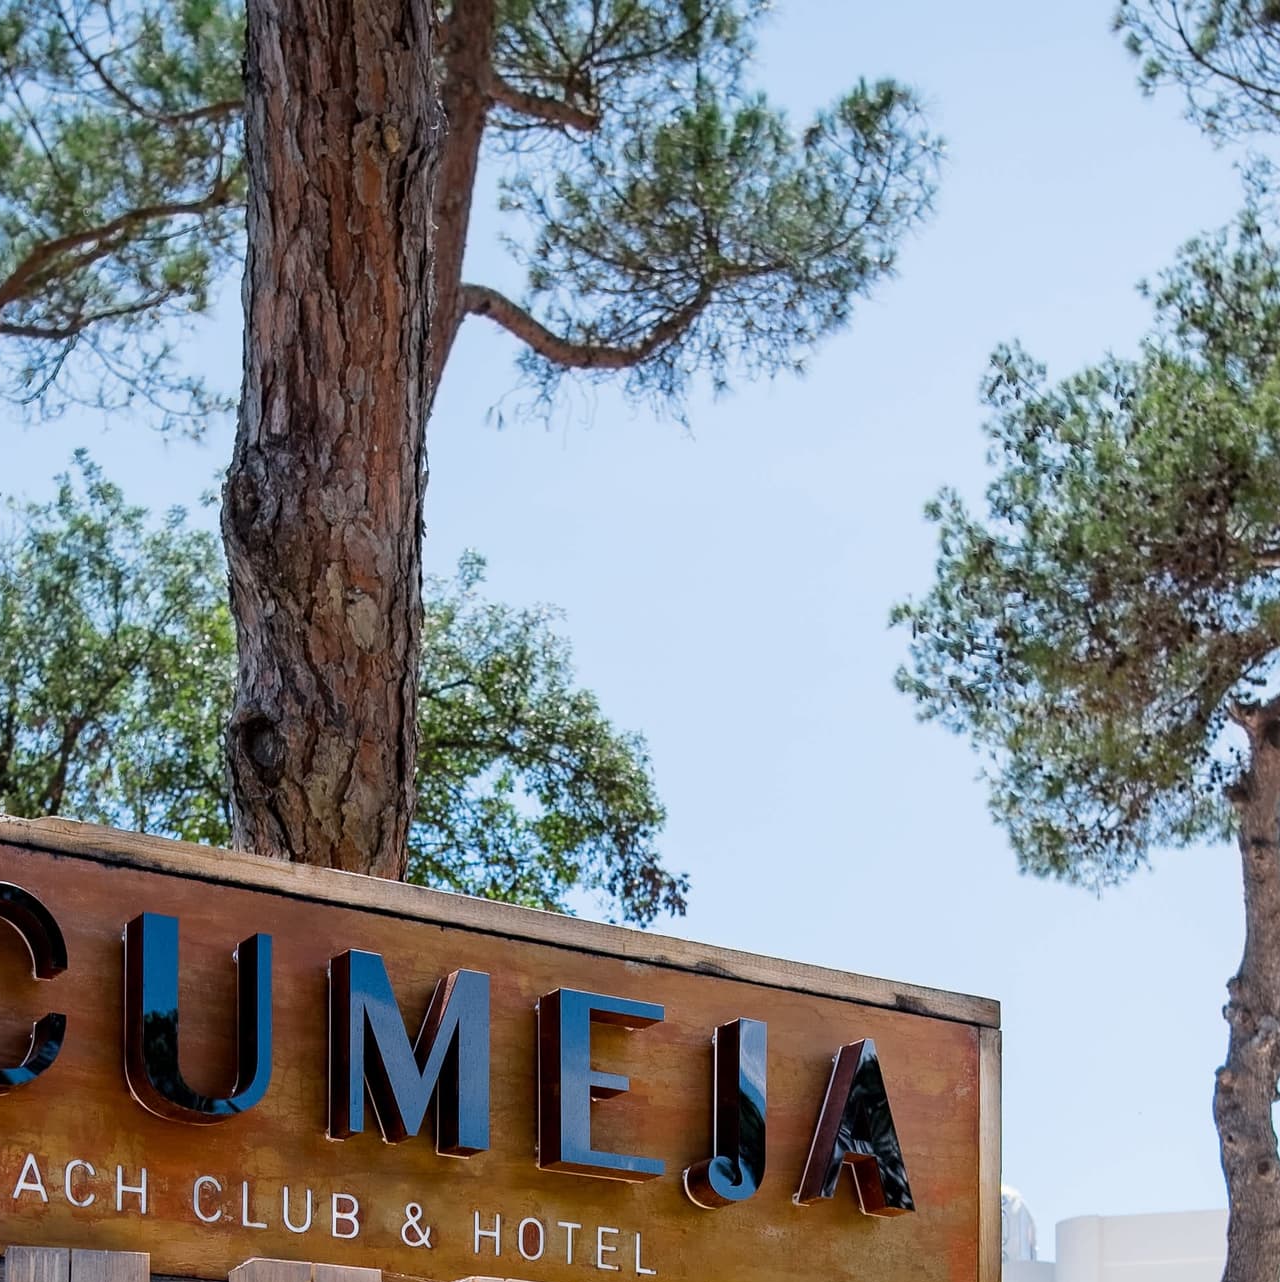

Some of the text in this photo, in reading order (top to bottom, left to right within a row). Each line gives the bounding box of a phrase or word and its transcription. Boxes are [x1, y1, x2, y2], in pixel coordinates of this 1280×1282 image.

[192, 1175, 361, 1240] CLUB
[400, 1202, 433, 1249] &
[473, 1210, 657, 1276] HOTEL
